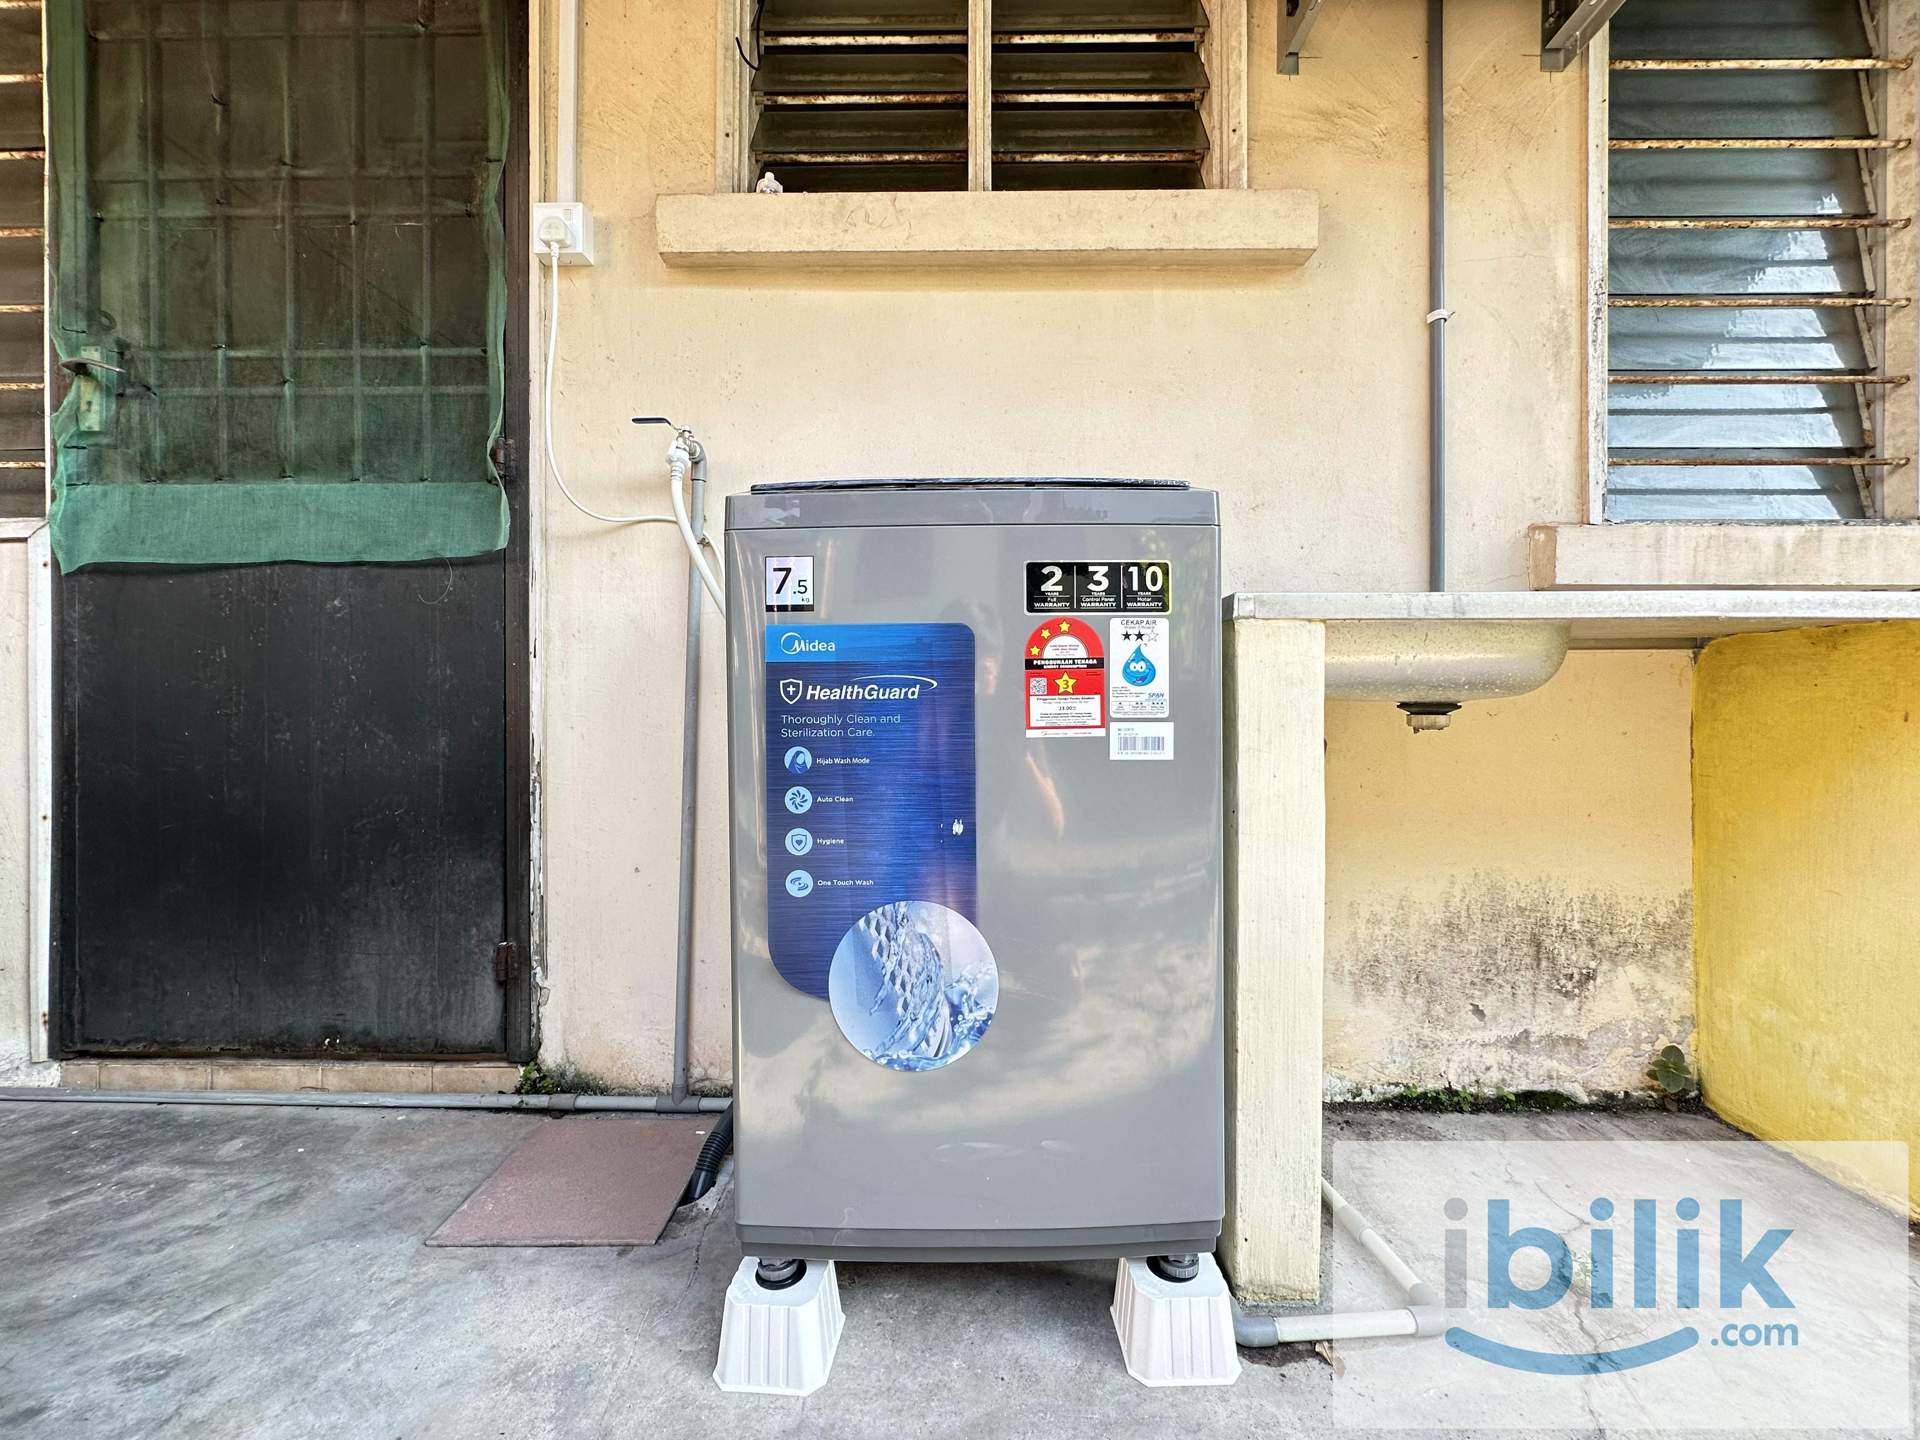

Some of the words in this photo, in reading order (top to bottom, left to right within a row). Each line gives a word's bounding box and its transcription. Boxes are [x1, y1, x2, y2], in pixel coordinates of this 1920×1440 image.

[1040, 566, 1063, 591] 2
[1087, 566, 1109, 591] 3
[1128, 566, 1163, 591] 10
[786, 636, 836, 652] Midea
[1063, 680, 1069, 689] 3
[806, 684, 920, 700] HealthGuard
[781, 714, 843, 726] Thoroughly
[847, 714, 877, 724] Clean
[880, 714, 901, 724] and
[781, 728, 844, 737] Sterilization
[847, 728, 875, 737] Care.
[816, 757, 832, 765] Hijab
[817, 837, 844, 845] Hygiene
